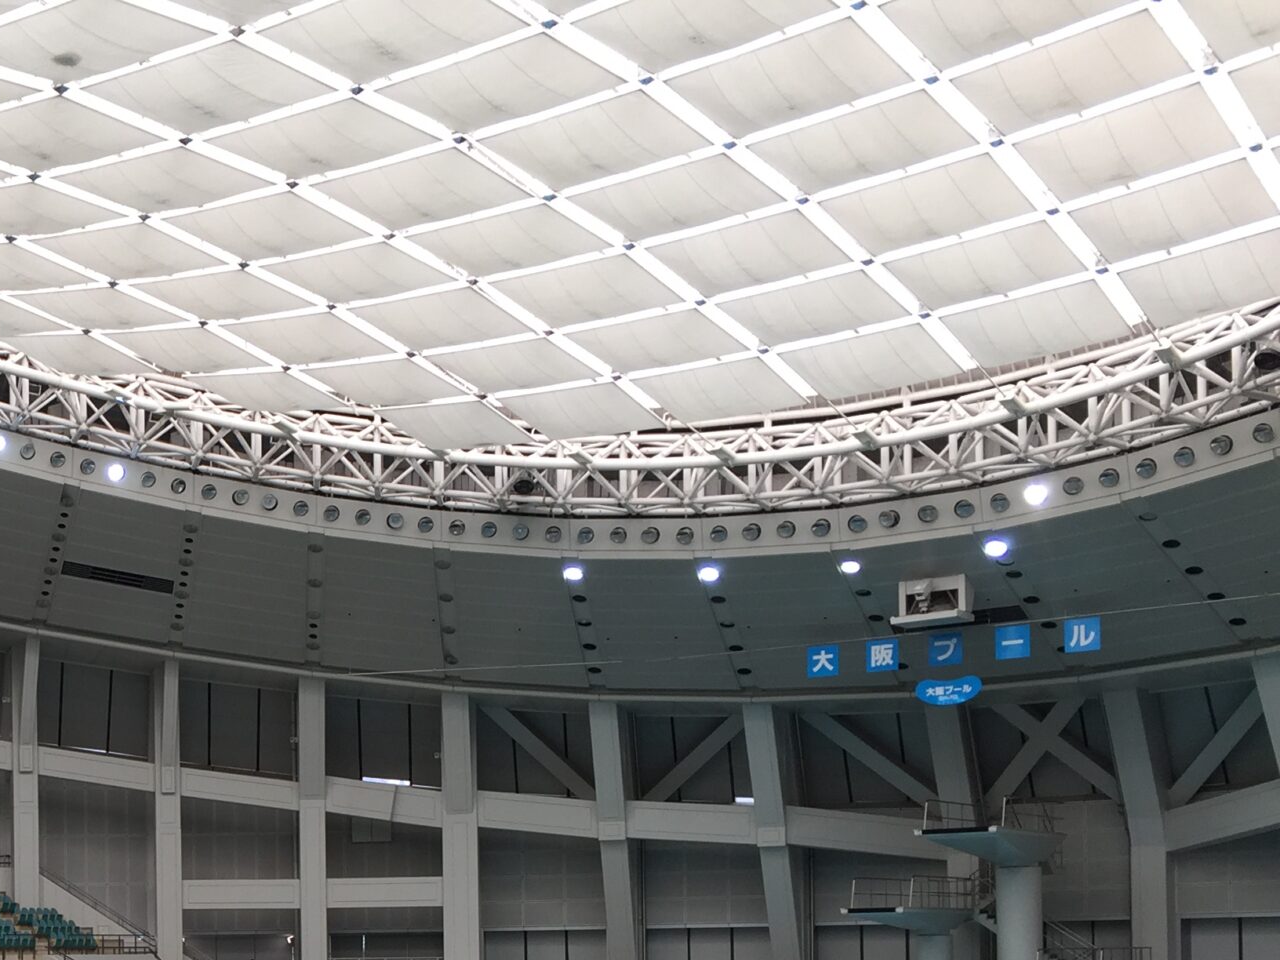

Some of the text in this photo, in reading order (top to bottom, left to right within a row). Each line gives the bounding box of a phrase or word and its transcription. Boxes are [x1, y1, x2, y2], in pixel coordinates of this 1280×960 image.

[812, 624, 1096, 673] 大阪プール
